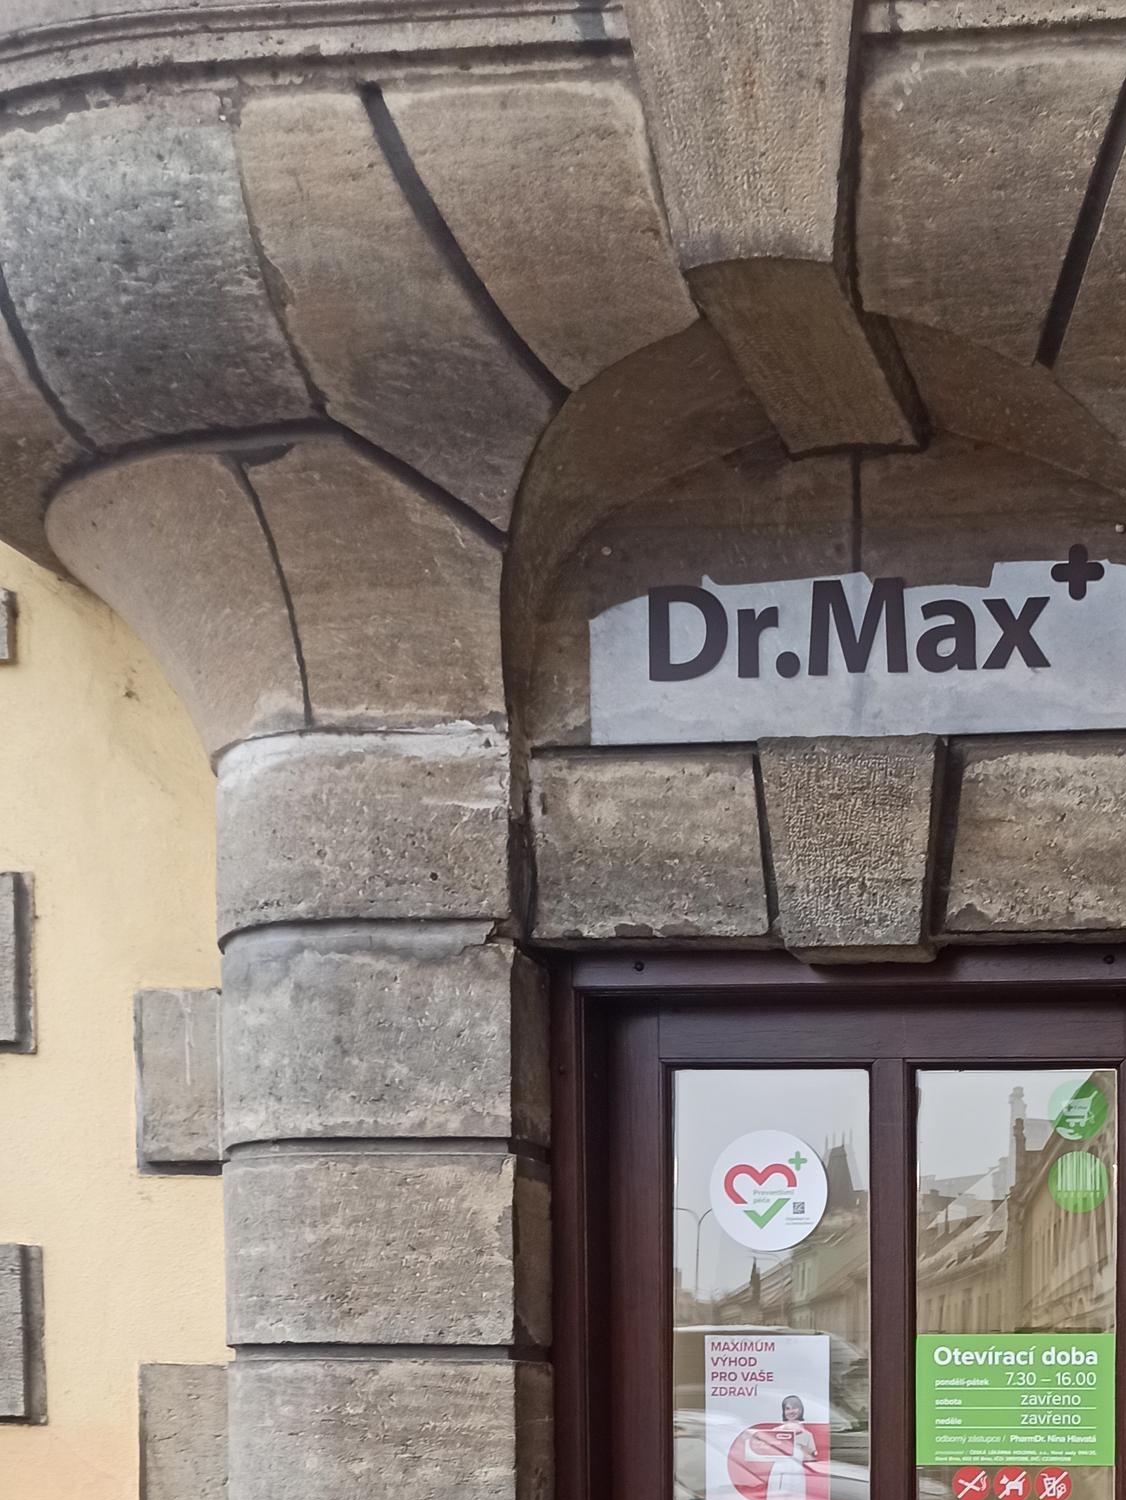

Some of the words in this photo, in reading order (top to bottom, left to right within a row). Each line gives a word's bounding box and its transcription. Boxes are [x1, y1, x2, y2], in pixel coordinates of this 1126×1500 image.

[711, 1341, 775, 1352] MAXIMUM
[711, 1354, 757, 1367] VÝHOD
[934, 1346, 1036, 1366] Otevírací
[1042, 1346, 1098, 1366] doba
[711, 1371, 738, 1382] PRO
[742, 1369, 774, 1382] VAŠE
[1005, 1372, 1036, 1387] 7.30
[1056, 1372, 1096, 1387] 16.00
[711, 1384, 758, 1397] ZDRAVÍ
[1020, 1391, 1081, 1406] zavřeno
[1020, 1410, 1081, 1425] zavřeno
